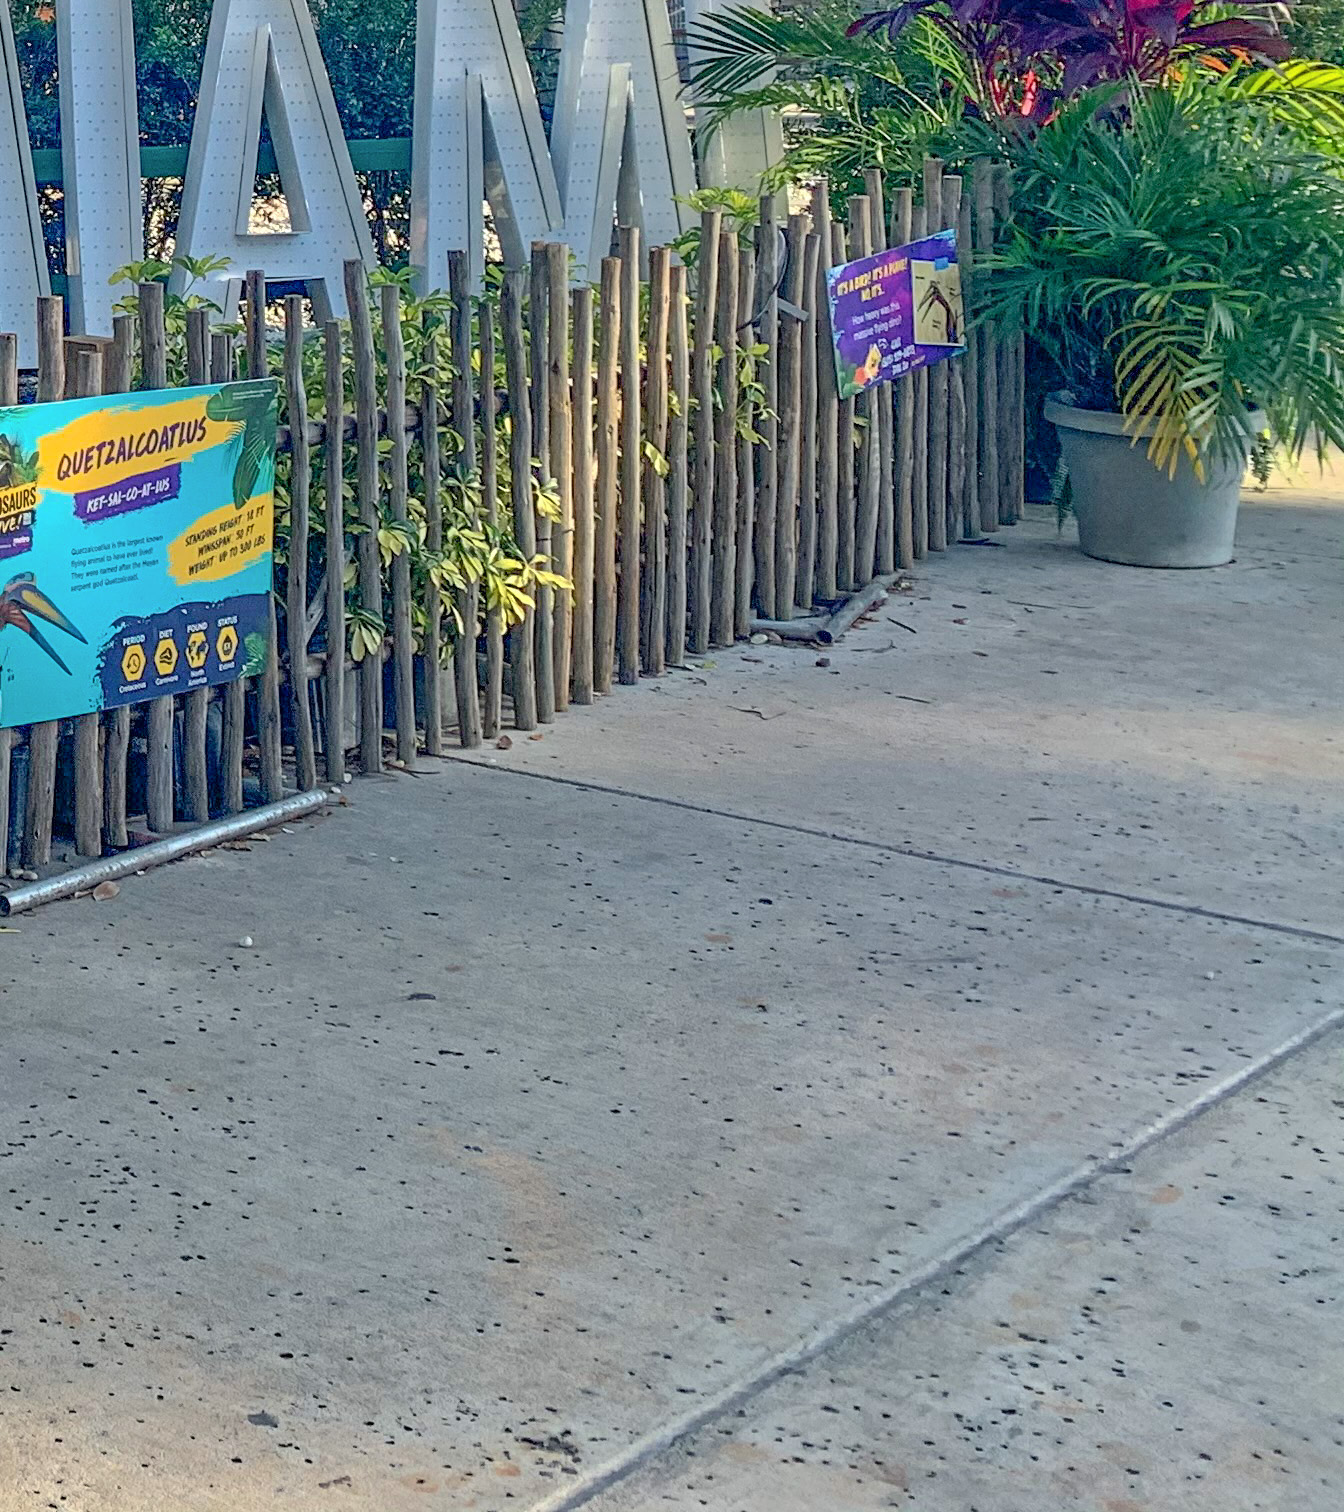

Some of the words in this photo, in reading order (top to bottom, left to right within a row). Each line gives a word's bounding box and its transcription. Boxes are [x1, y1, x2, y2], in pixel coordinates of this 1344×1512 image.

[57, 416, 207, 481] QUETZALCOATLUS
[87, 477, 170, 514] KET-SAL-CO-AT-LUS
[185, 525, 217, 547] STANDING
[256, 505, 265, 517] FT
[246, 523, 255, 536] FT
[230, 546, 238, 557] TO
[187, 621, 208, 633] FOUND
[217, 615, 238, 627] STATUS
[159, 628, 173, 639] DIET
[122, 634, 146, 646] PERIOD
